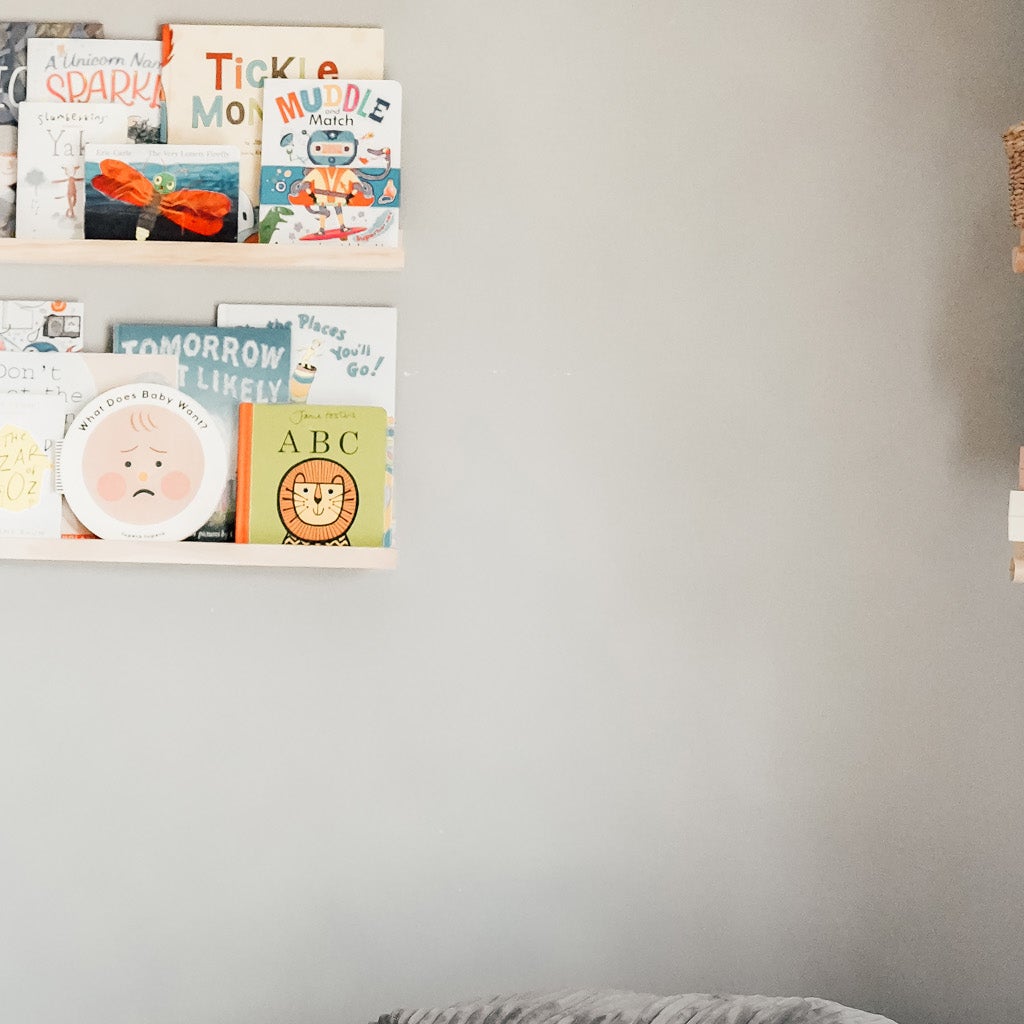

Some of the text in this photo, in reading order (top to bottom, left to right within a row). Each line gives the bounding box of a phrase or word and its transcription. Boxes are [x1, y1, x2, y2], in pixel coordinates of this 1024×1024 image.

[63, 54, 125, 68] Unicorn
[275, 83, 391, 124] MUDDLE
[309, 114, 354, 126] Match
[297, 313, 348, 341] Places
[121, 332, 286, 370] TOMORROW
[329, 343, 371, 361] You'll
[346, 356, 385, 378] Go!
[196, 365, 283, 403] LIKELY
[78, 406, 103, 432] What
[106, 392, 137, 407] Does
[142, 390, 173, 405] Baby
[177, 400, 208, 431] Want?
